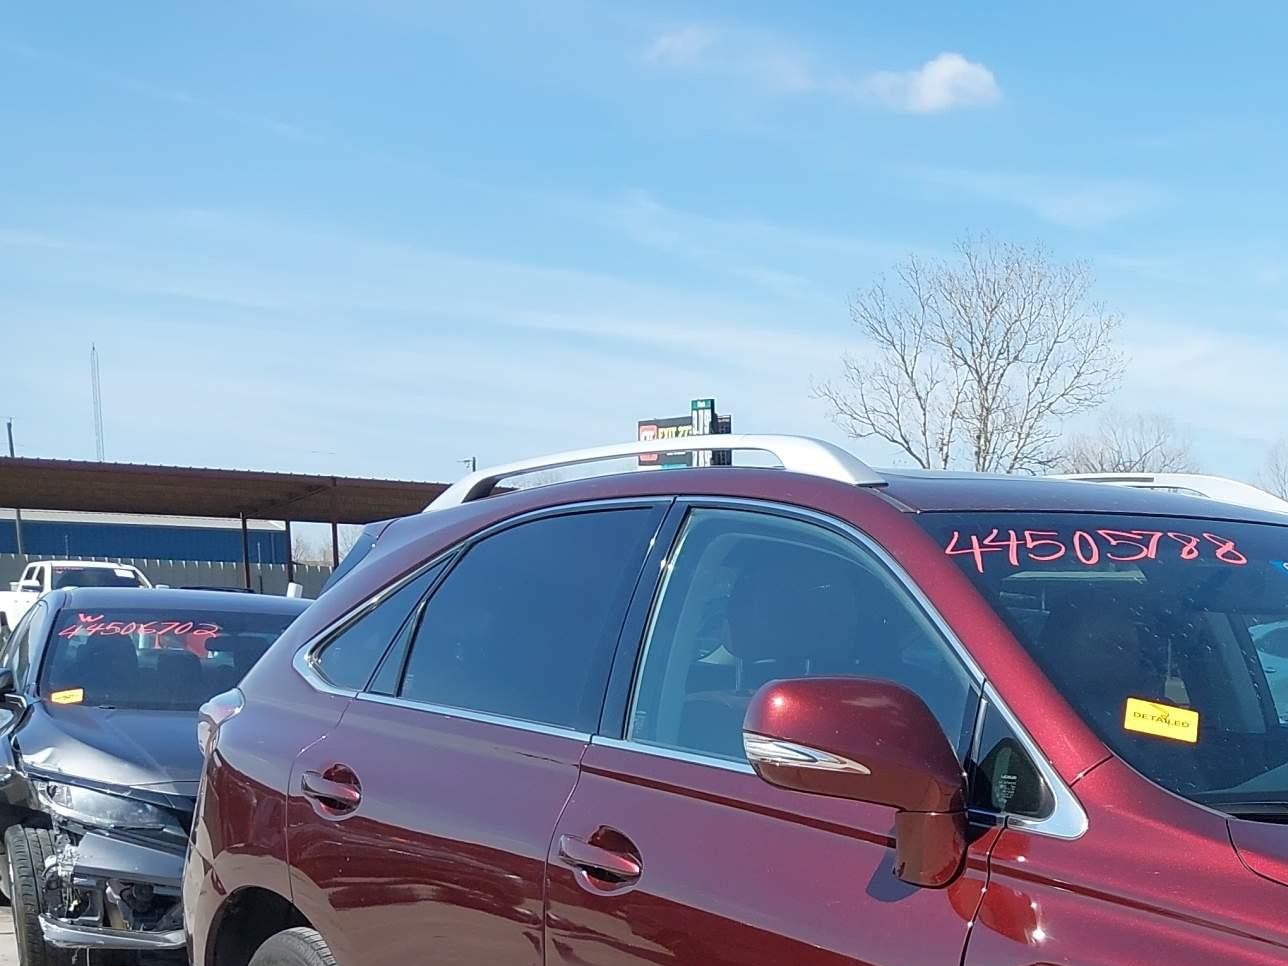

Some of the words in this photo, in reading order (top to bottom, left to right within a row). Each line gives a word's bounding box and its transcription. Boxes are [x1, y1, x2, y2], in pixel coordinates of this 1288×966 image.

[945, 528, 1248, 573] 44505788
[58, 621, 219, 639] 44506702
[1133, 711, 1190, 728] DETAILED
